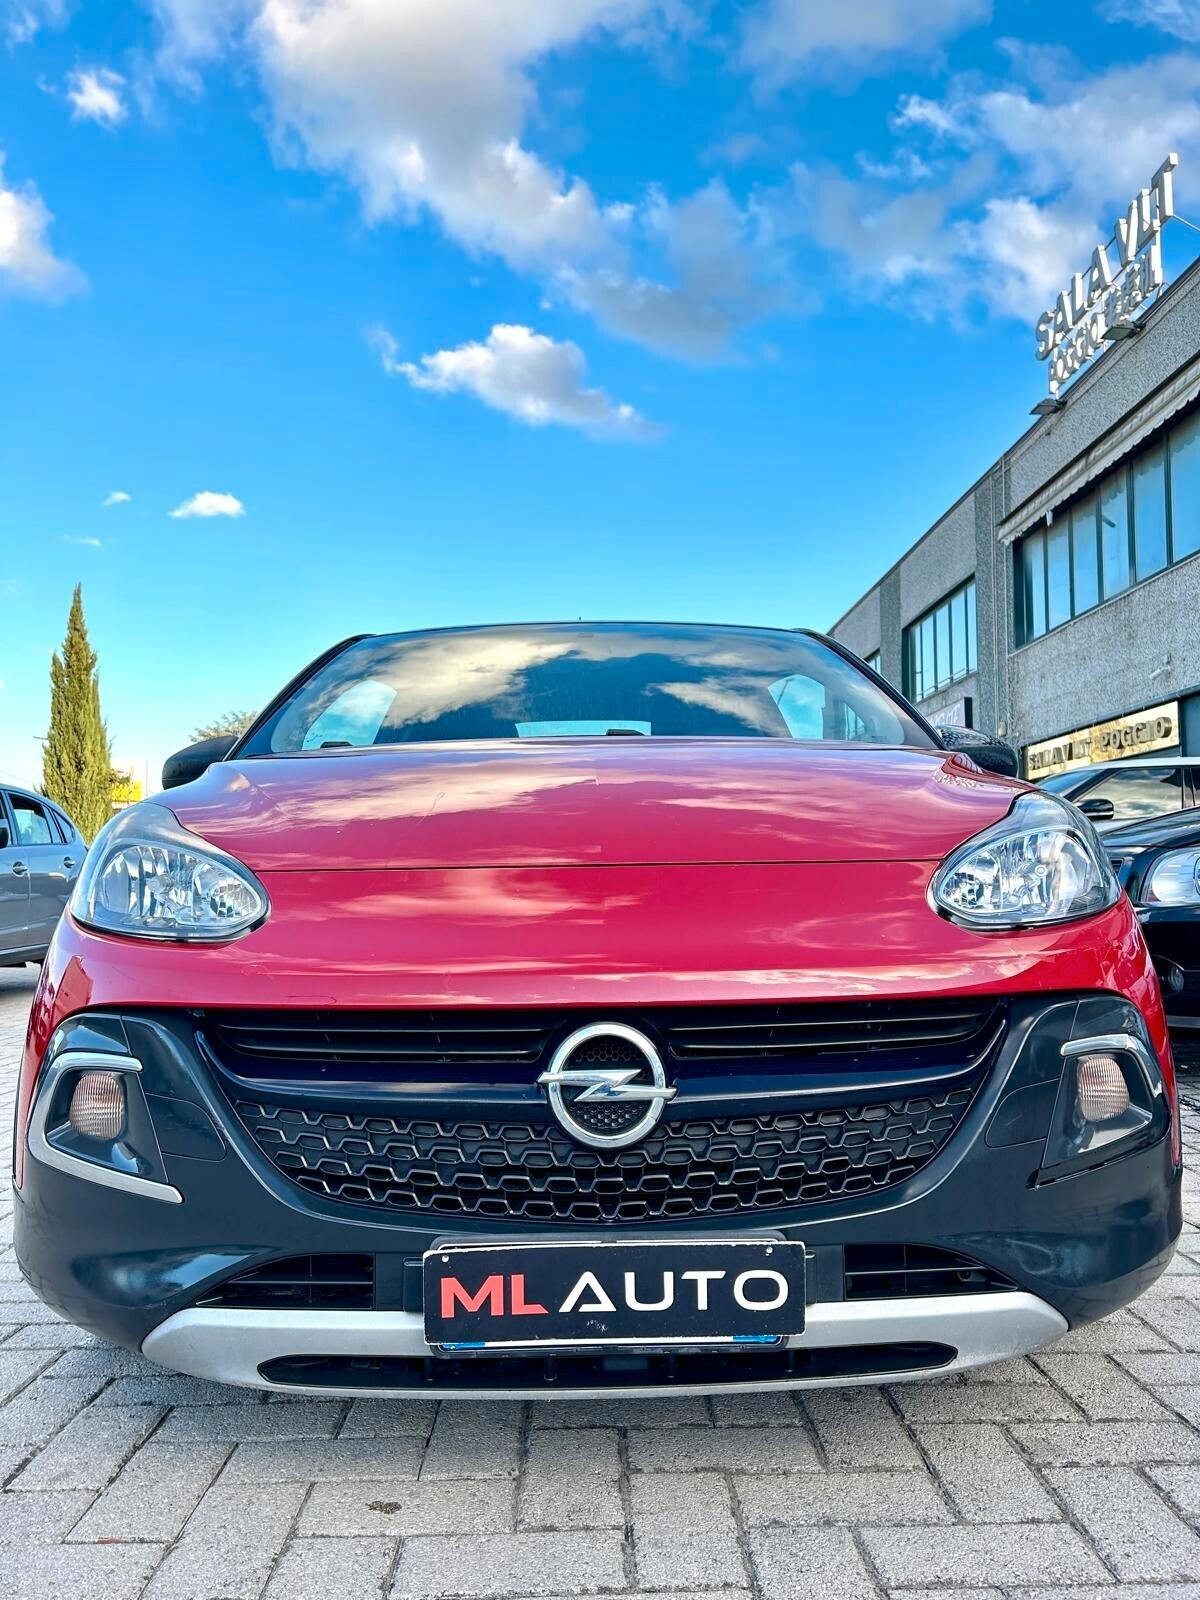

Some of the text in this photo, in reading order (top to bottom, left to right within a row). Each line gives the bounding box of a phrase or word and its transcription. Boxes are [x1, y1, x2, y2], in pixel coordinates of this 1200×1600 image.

[1036, 245, 1113, 361] SALA
[1048, 311, 1106, 395] POGGIO
[1028, 746, 1065, 771] SALA
[1100, 716, 1173, 753] POGGIO
[440, 1269, 789, 1319] ML AUTO
